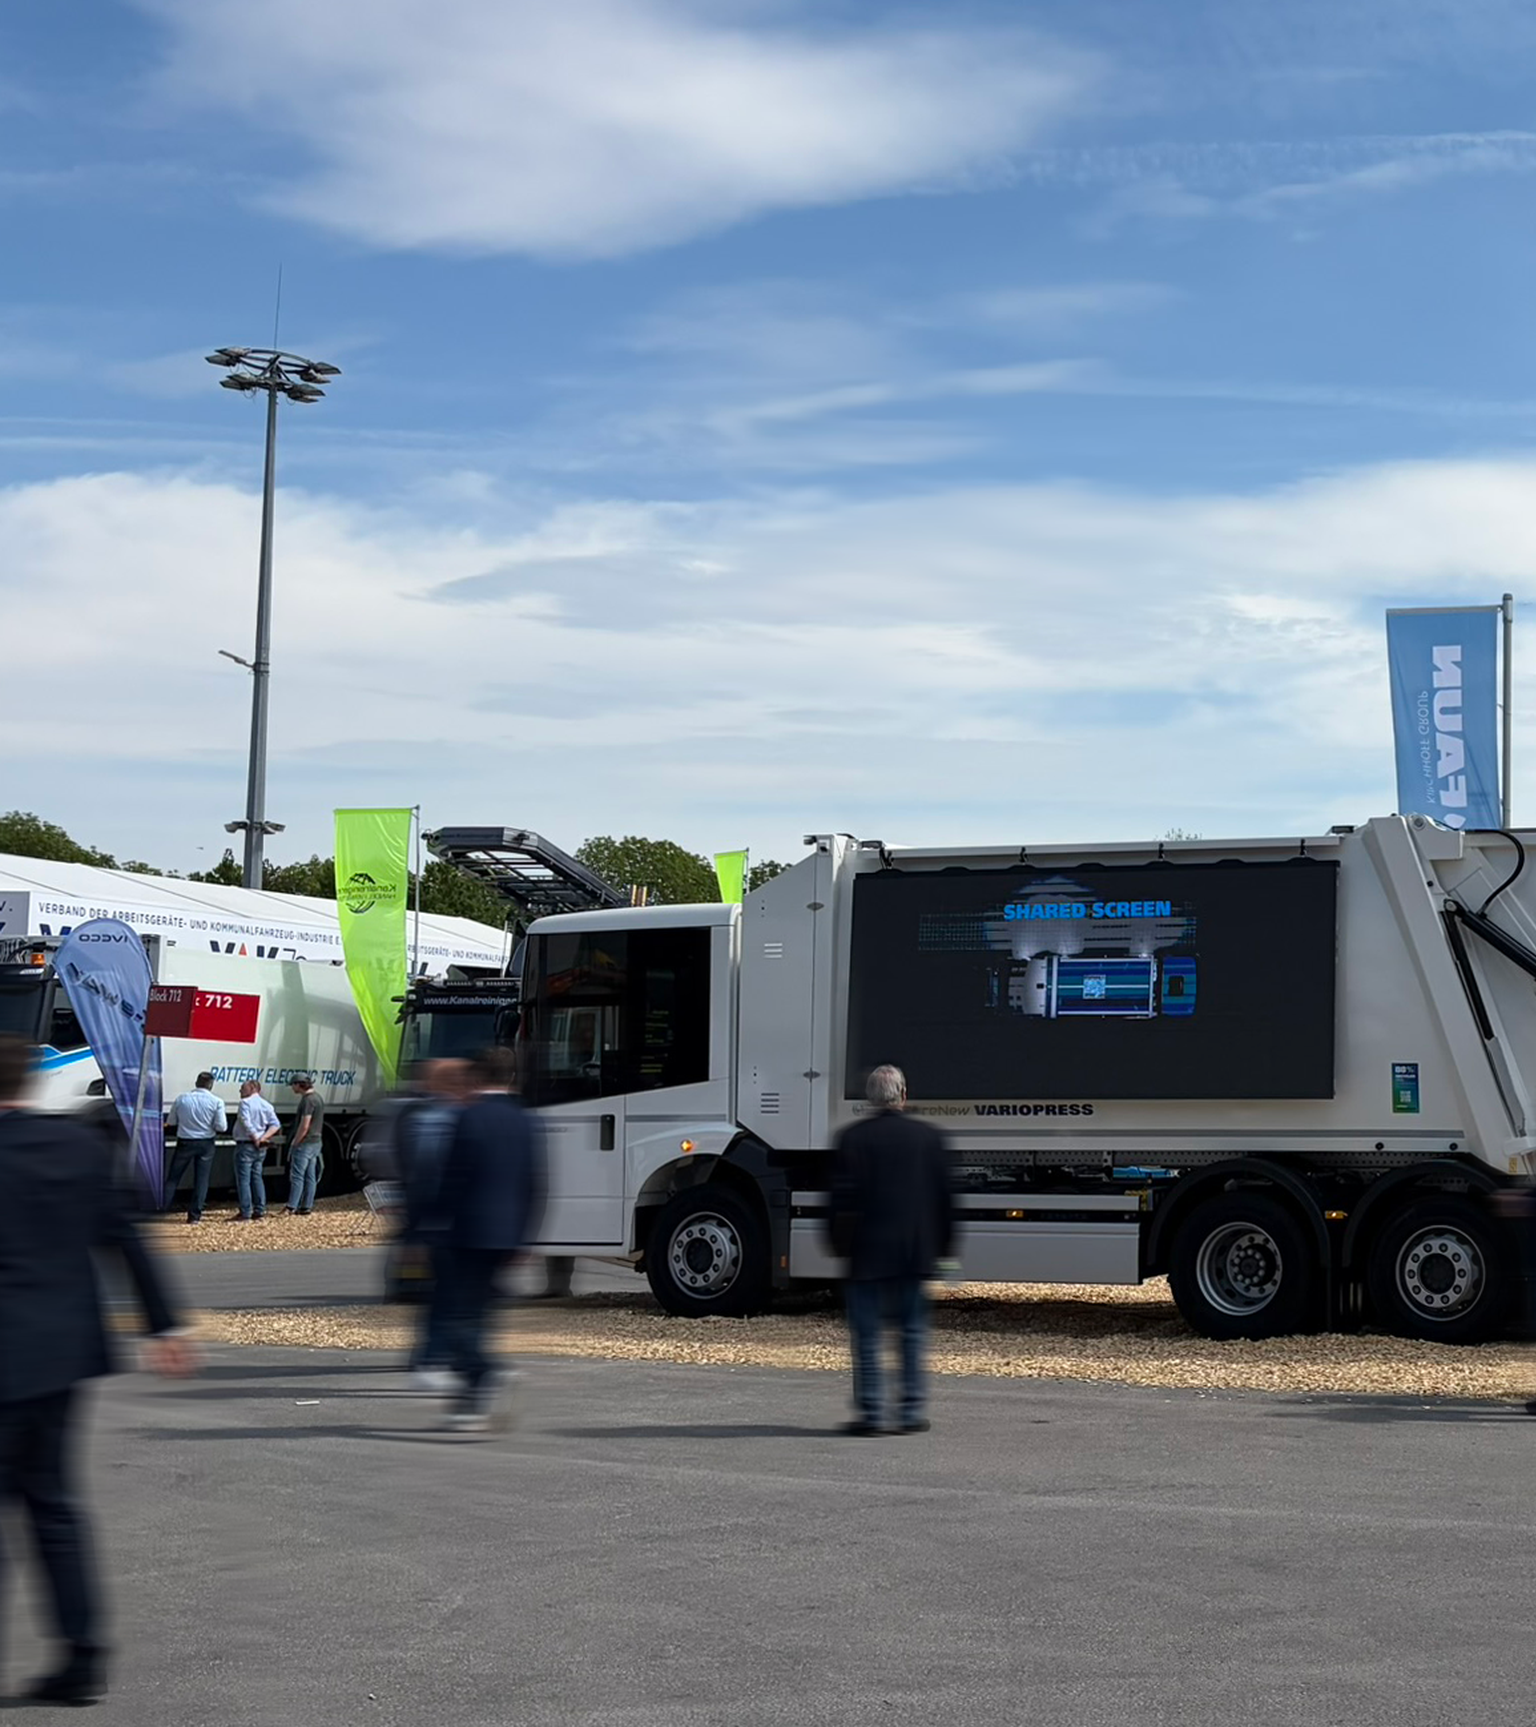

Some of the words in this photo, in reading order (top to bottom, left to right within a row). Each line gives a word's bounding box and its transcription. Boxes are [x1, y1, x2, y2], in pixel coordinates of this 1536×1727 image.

[38, 902, 86, 917] VERBAND
[89, 908, 109, 919] DER
[112, 911, 188, 928] ARBEITSGERÄTE-
[189, 919, 208, 930] UND
[1003, 903, 1087, 920] SHARED
[1092, 901, 1172, 918] SCREEN
[168, 989, 182, 1003] 712
[204, 994, 233, 1009] 712
[210, 1066, 263, 1084] BATTERY
[320, 1069, 356, 1086] TRUCK
[974, 1103, 1094, 1116] VARIOPRESS
